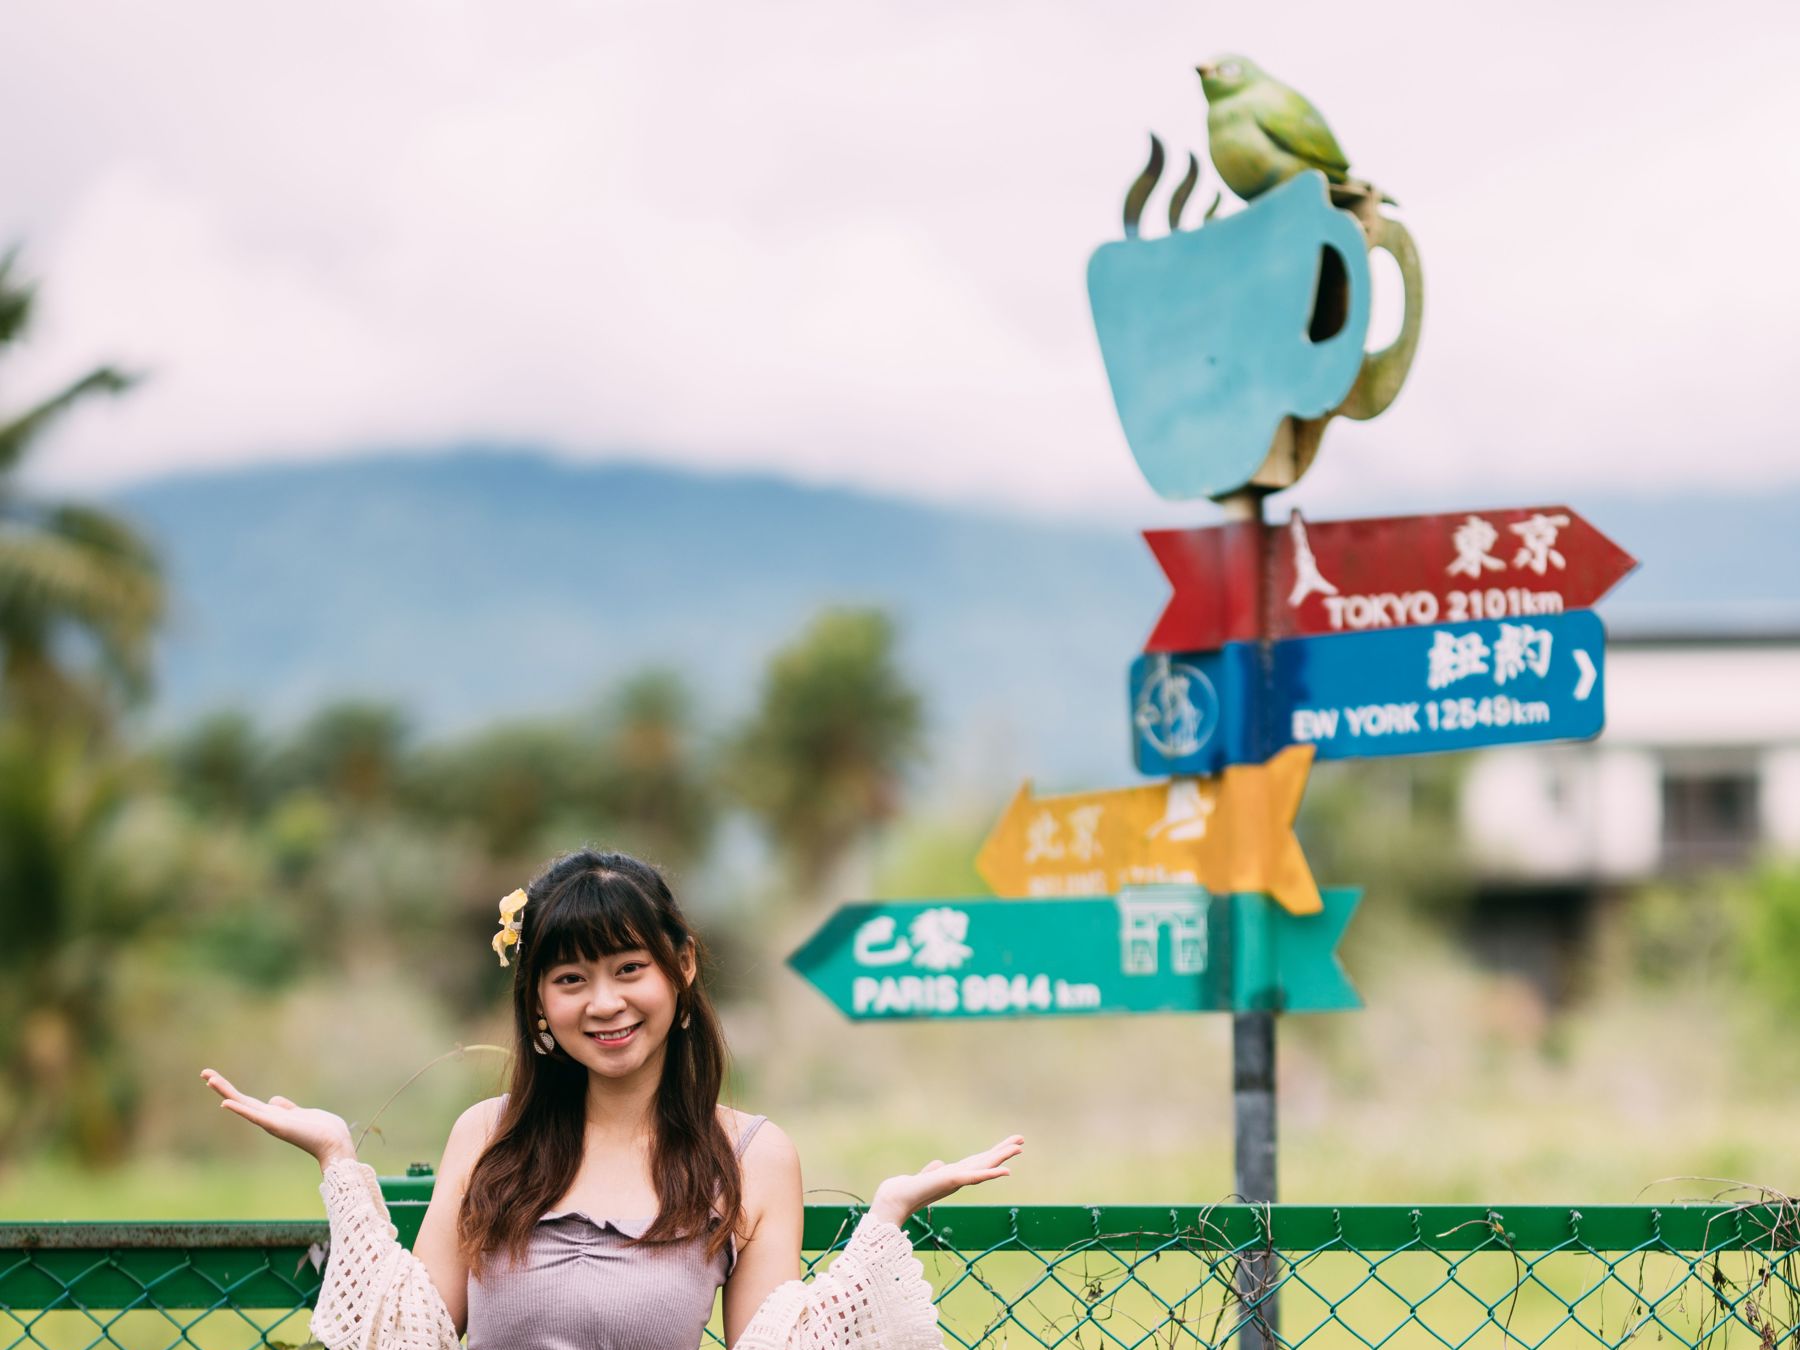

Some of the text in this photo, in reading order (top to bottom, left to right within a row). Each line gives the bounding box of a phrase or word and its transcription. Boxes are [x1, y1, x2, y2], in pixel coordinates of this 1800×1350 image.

[1445, 514, 1570, 579] 東京
[1323, 590, 1439, 630] TOKYO
[1427, 623, 1553, 690] 紐約
[1344, 702, 1420, 737] YORK
[853, 907, 974, 971] 巴黎
[853, 974, 959, 1014] PARIS
[1055, 979, 1101, 1009] km
